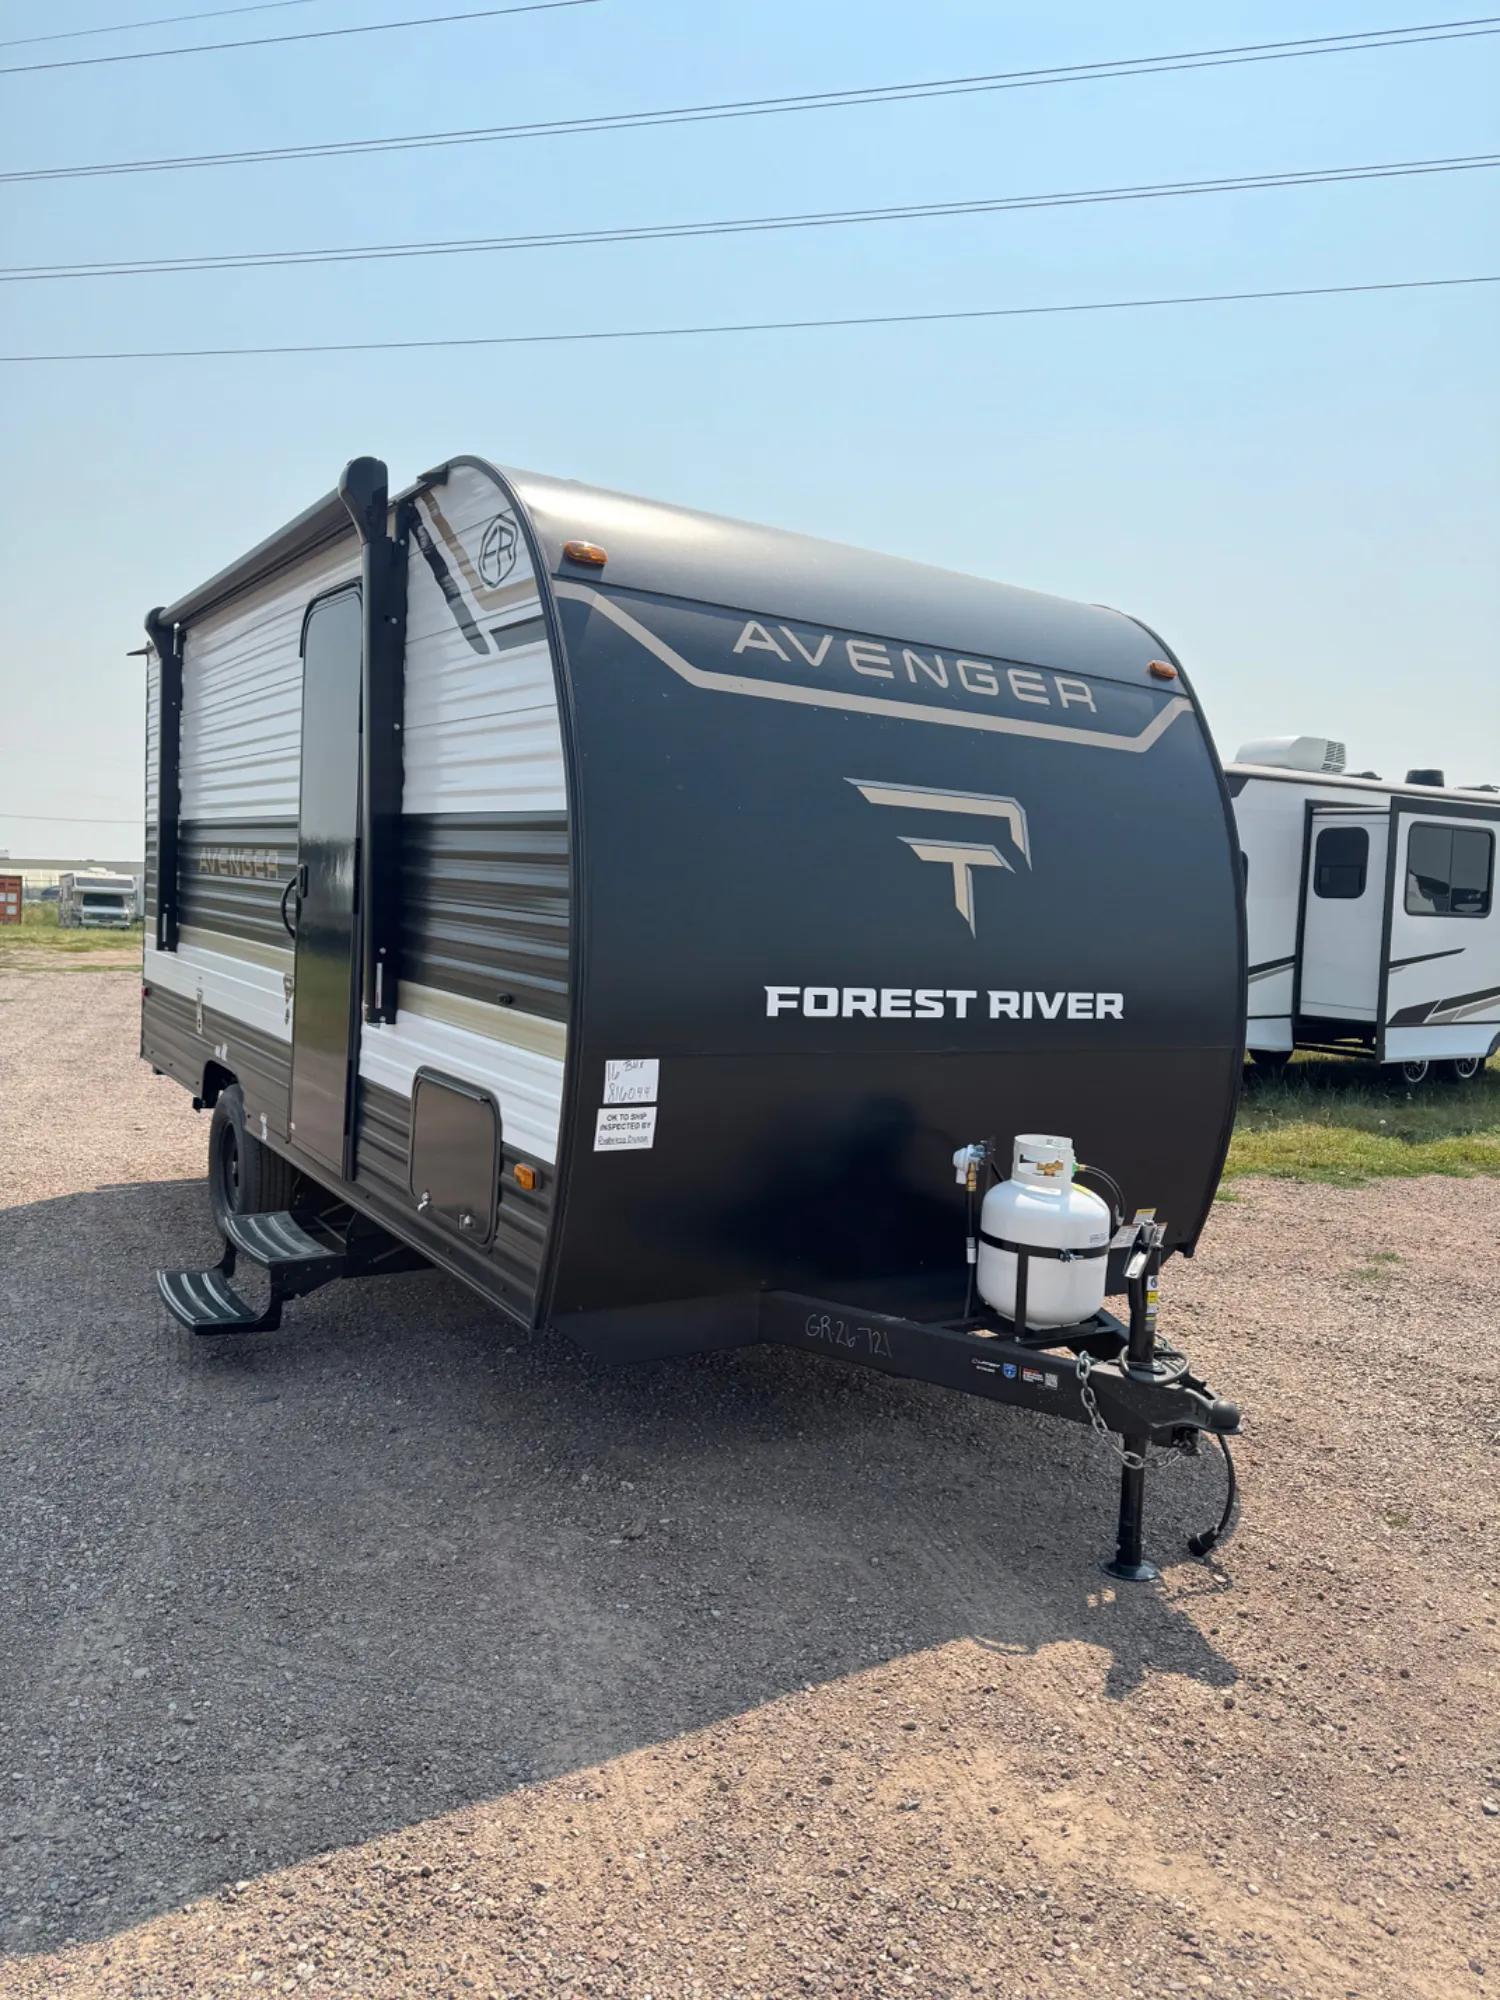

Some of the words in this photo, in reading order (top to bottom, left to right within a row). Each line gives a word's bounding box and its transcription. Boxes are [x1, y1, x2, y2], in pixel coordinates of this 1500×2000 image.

[733, 620, 1097, 713] AVENGER
[199, 848, 279, 879] AVENGER
[764, 985, 977, 1018] FOREST
[987, 990, 1124, 1020] RIVER
[600, 1122, 640, 1131] INSPECTED
[606, 1114, 617, 1122] OK
[620, 1113, 630, 1121] TO
[630, 1112, 648, 1121] SHIP
